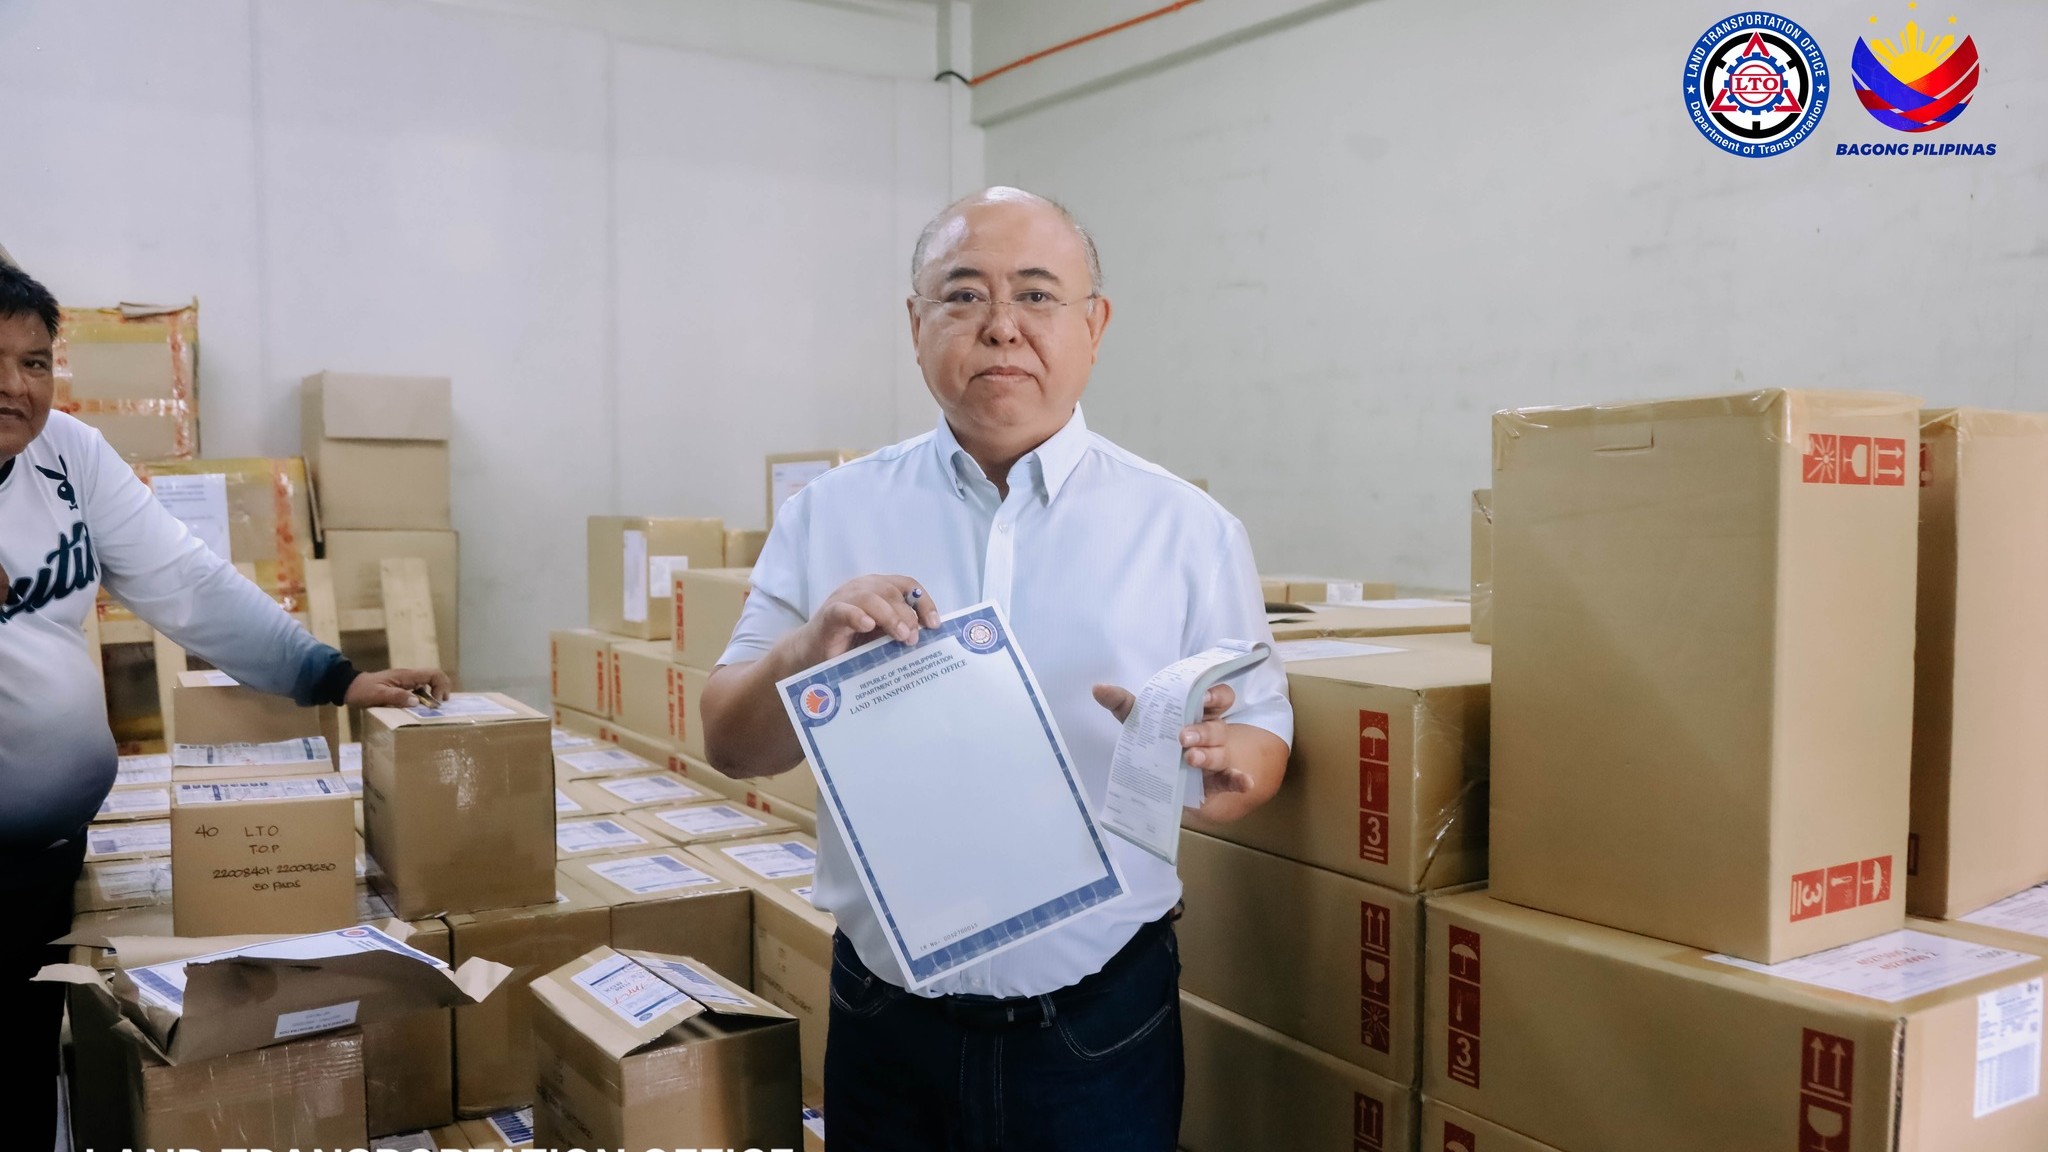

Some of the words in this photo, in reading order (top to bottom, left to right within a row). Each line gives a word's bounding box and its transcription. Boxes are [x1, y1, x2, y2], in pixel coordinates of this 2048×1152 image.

[855, 680, 893, 700] DEPARTMENT
[903, 654, 953, 679] TRANSPORTATION
[860, 674, 887, 689] REPUBLIC
[897, 665, 907, 674] THE
[909, 650, 943, 668] PHILIPPINES
[850, 701, 870, 715] LAND
[873, 671, 939, 705] TRANSPORTATION
[940, 659, 968, 675] OFFICE
[195, 824, 219, 838] 40
[1368, 817, 1380, 845] 3
[1802, 882, 1823, 907] 3
[1457, 1037, 1471, 1067] 3
